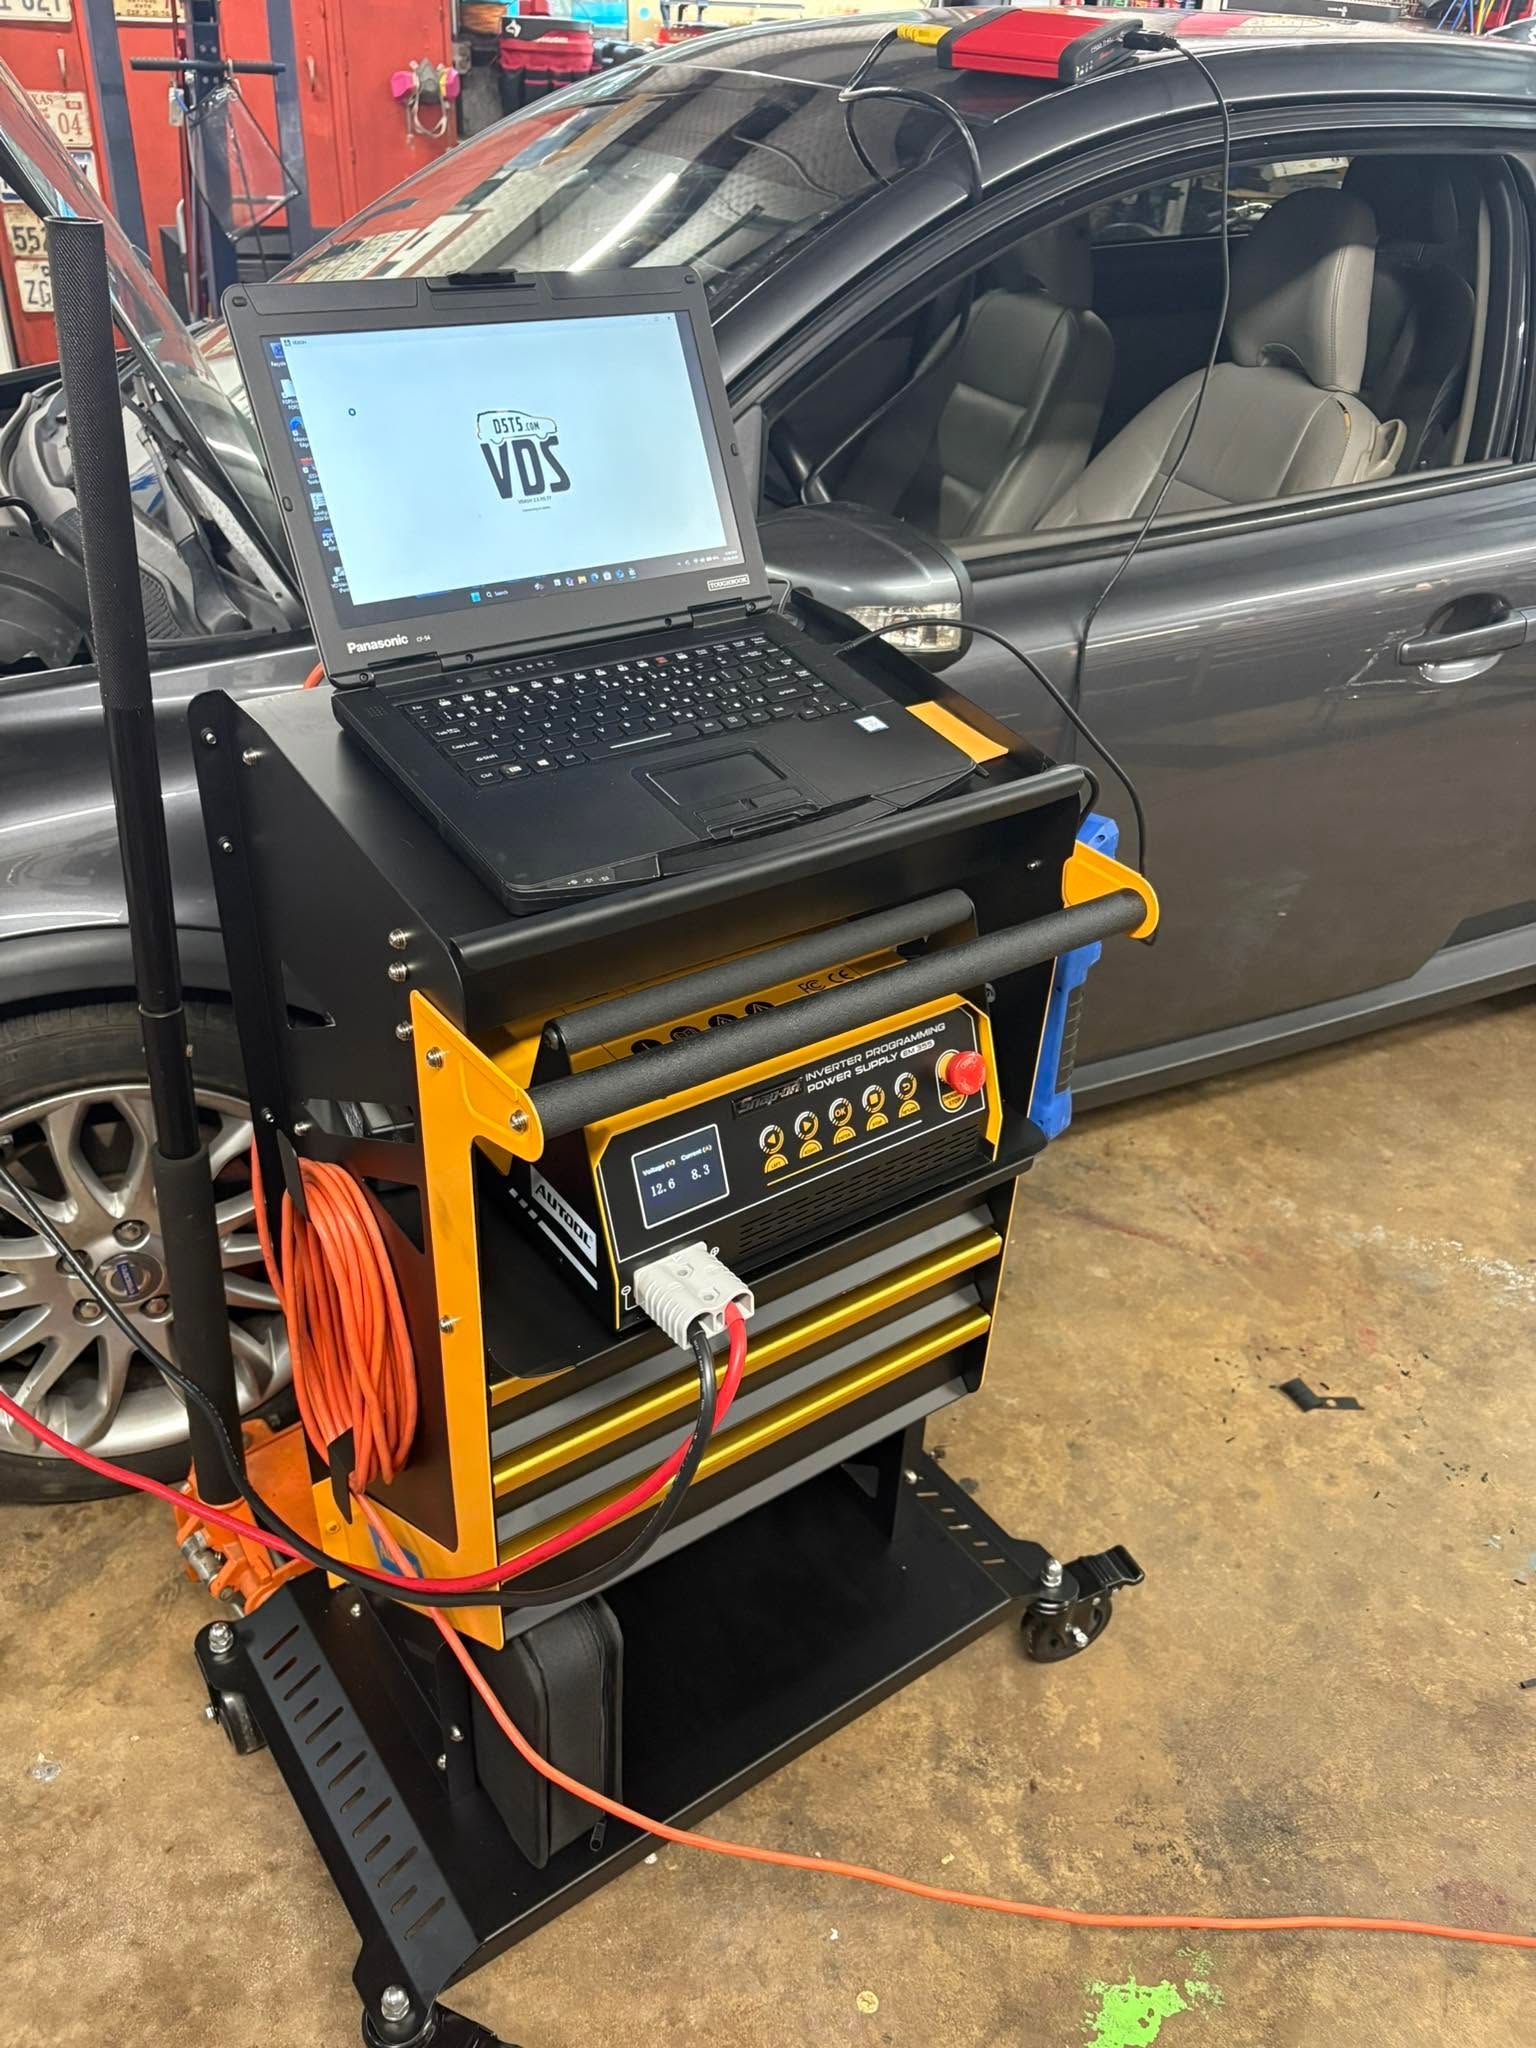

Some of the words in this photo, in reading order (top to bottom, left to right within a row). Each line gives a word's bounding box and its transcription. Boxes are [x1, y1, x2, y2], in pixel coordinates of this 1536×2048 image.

[58, 112, 83, 136] 04
[480, 435, 571, 500] VDS
[346, 634, 409, 654] Panasonic
[828, 970, 854, 984] CE
[805, 1053, 862, 1082] INVERTER
[865, 1022, 946, 1059] PROGRAMMING
[807, 1071, 852, 1094] POWER
[855, 1051, 898, 1075] SUPPLY
[834, 1106, 847, 1118] OK
[690, 1163, 710, 1181] 8.3
[650, 1178, 676, 1198] 12.6
[535, 1184, 592, 1250] AUTOOL
